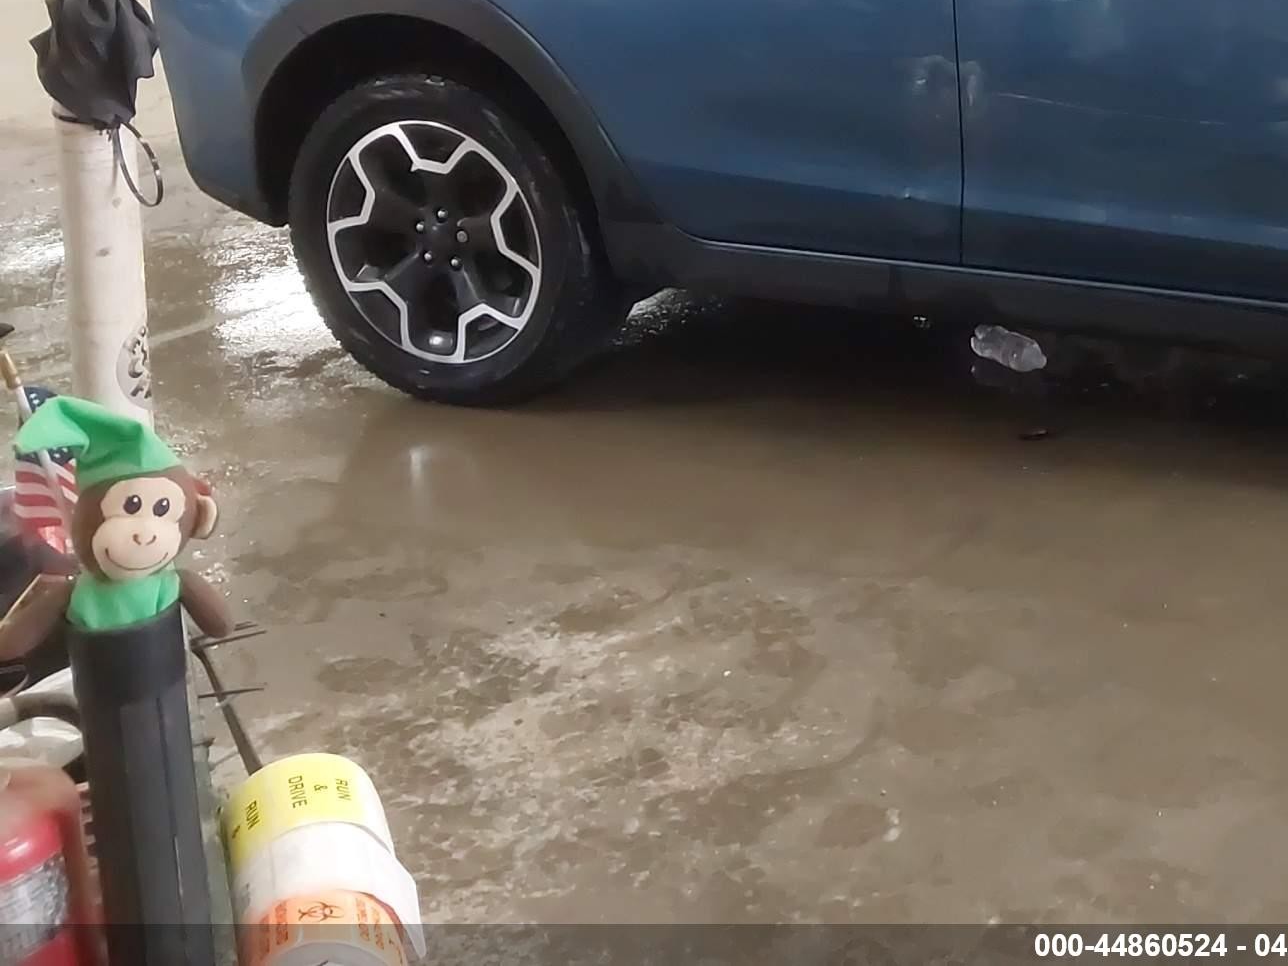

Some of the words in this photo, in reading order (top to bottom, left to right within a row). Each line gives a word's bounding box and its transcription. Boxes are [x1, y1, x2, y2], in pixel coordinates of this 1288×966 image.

[288, 775, 308, 809] DRIVE
[335, 777, 352, 801] RUN
[245, 800, 261, 831] RUN
